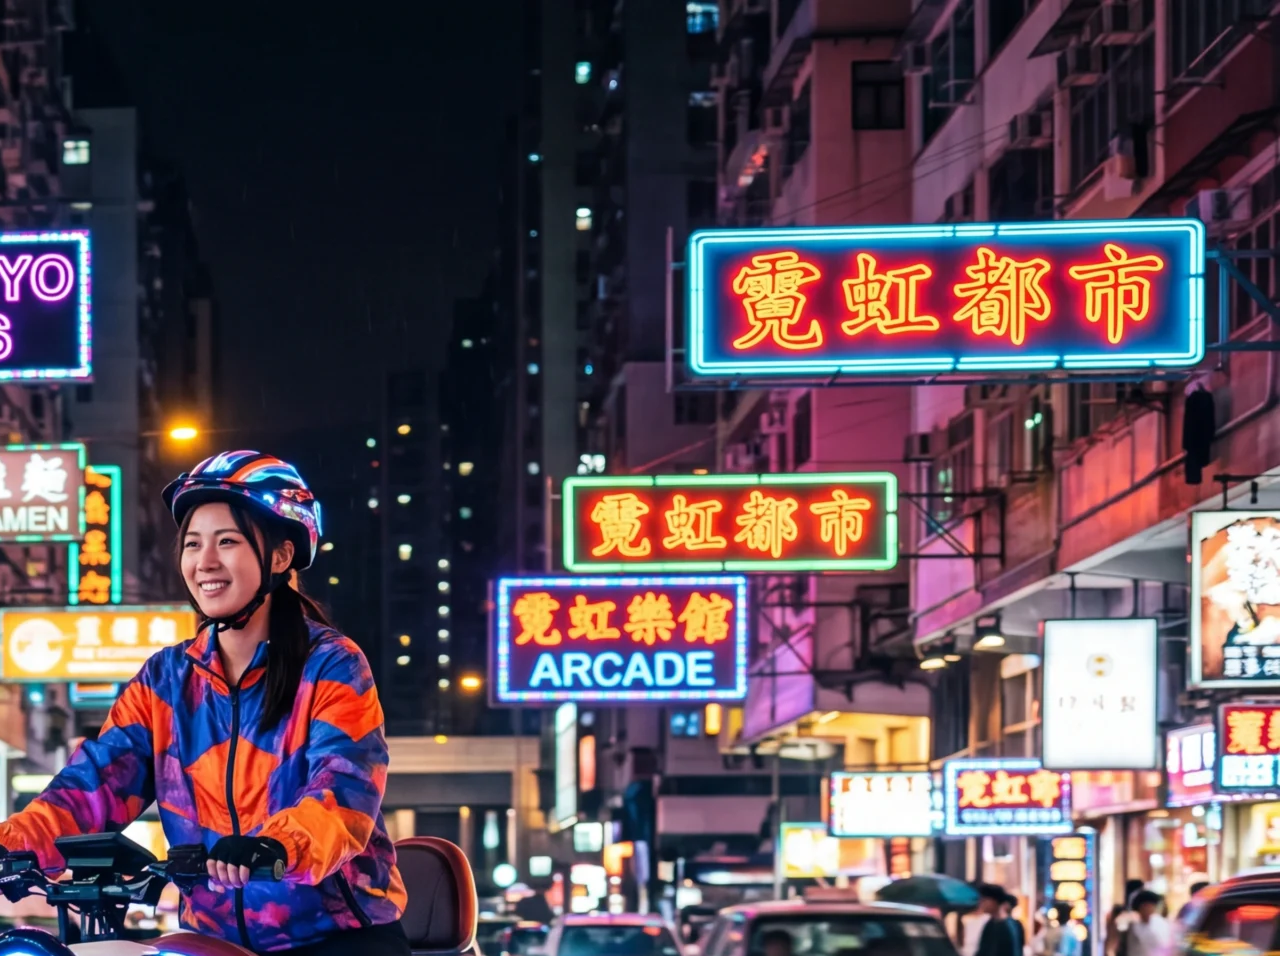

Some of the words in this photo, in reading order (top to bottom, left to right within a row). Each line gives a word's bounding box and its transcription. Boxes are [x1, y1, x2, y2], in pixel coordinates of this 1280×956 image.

[732, 243, 1165, 350] 霓虹都市
[591, 489, 871, 558] 霓虹都市
[513, 591, 733, 645] 霓虹樂館
[529, 651, 716, 687] ARCADE
